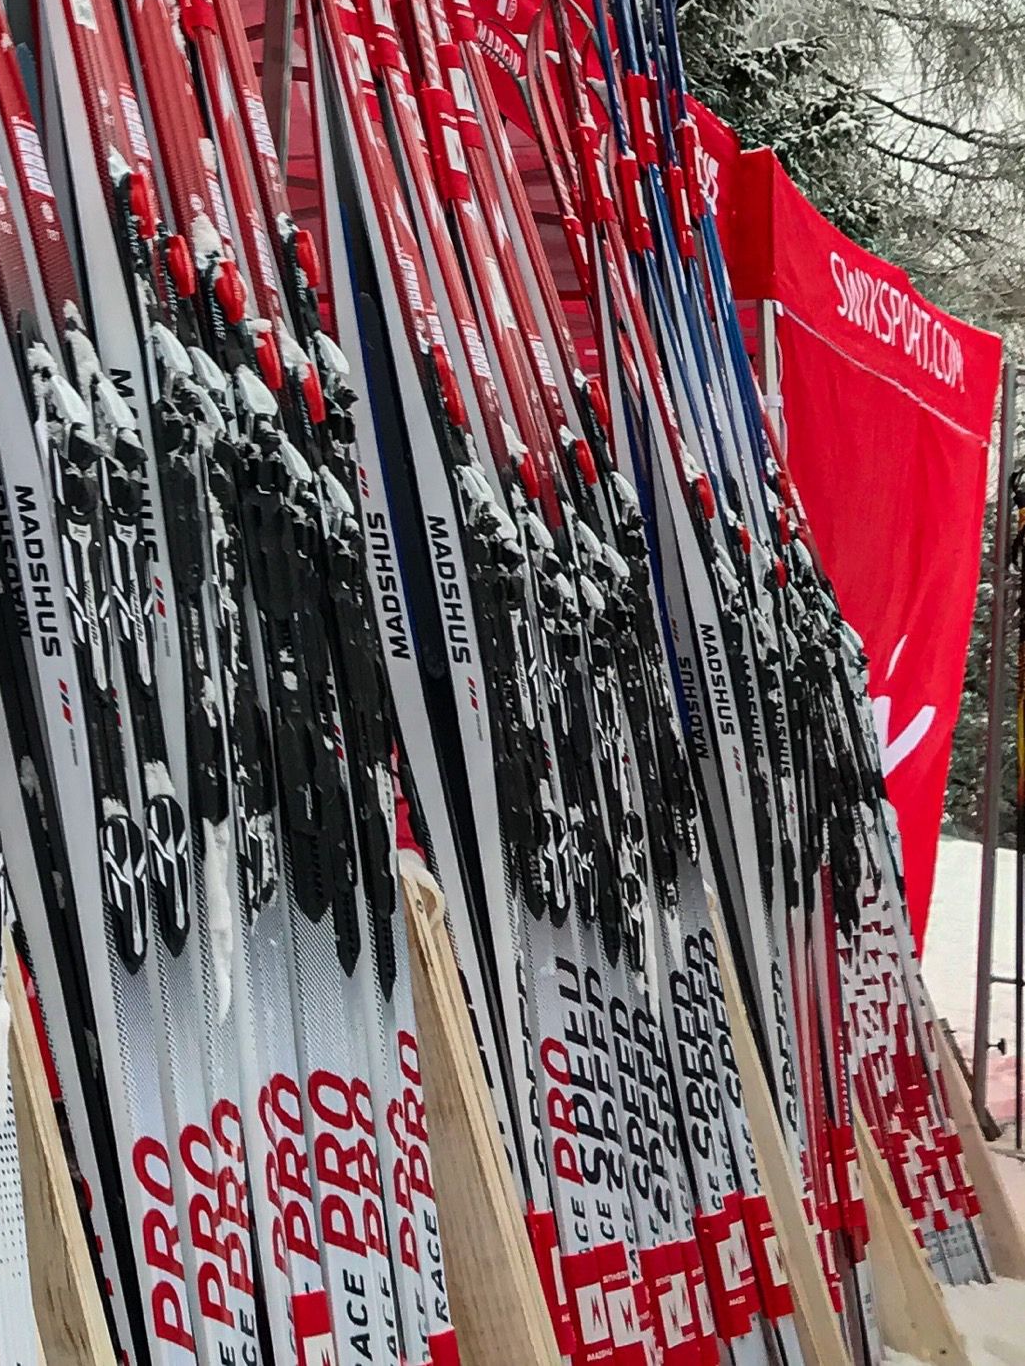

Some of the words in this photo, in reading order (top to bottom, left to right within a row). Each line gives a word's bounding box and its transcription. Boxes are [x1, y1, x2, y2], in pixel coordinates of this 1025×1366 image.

[830, 250, 966, 394] SWIXSPORT.COM
[14, 485, 62, 657] MADSHUS
[363, 512, 412, 660] MADSHUS
[426, 515, 472, 665] MADSHUS
[699, 623, 736, 735] MADSHUS
[270, 1073, 322, 1265] PRO
[308, 1069, 369, 1257] PRO
[540, 1036, 584, 1187] PRO
[133, 1136, 197, 1353] PRO
[179, 1124, 235, 1328] PRO
[211, 1098, 257, 1298] PRO
[342, 1268, 373, 1366] ACE
